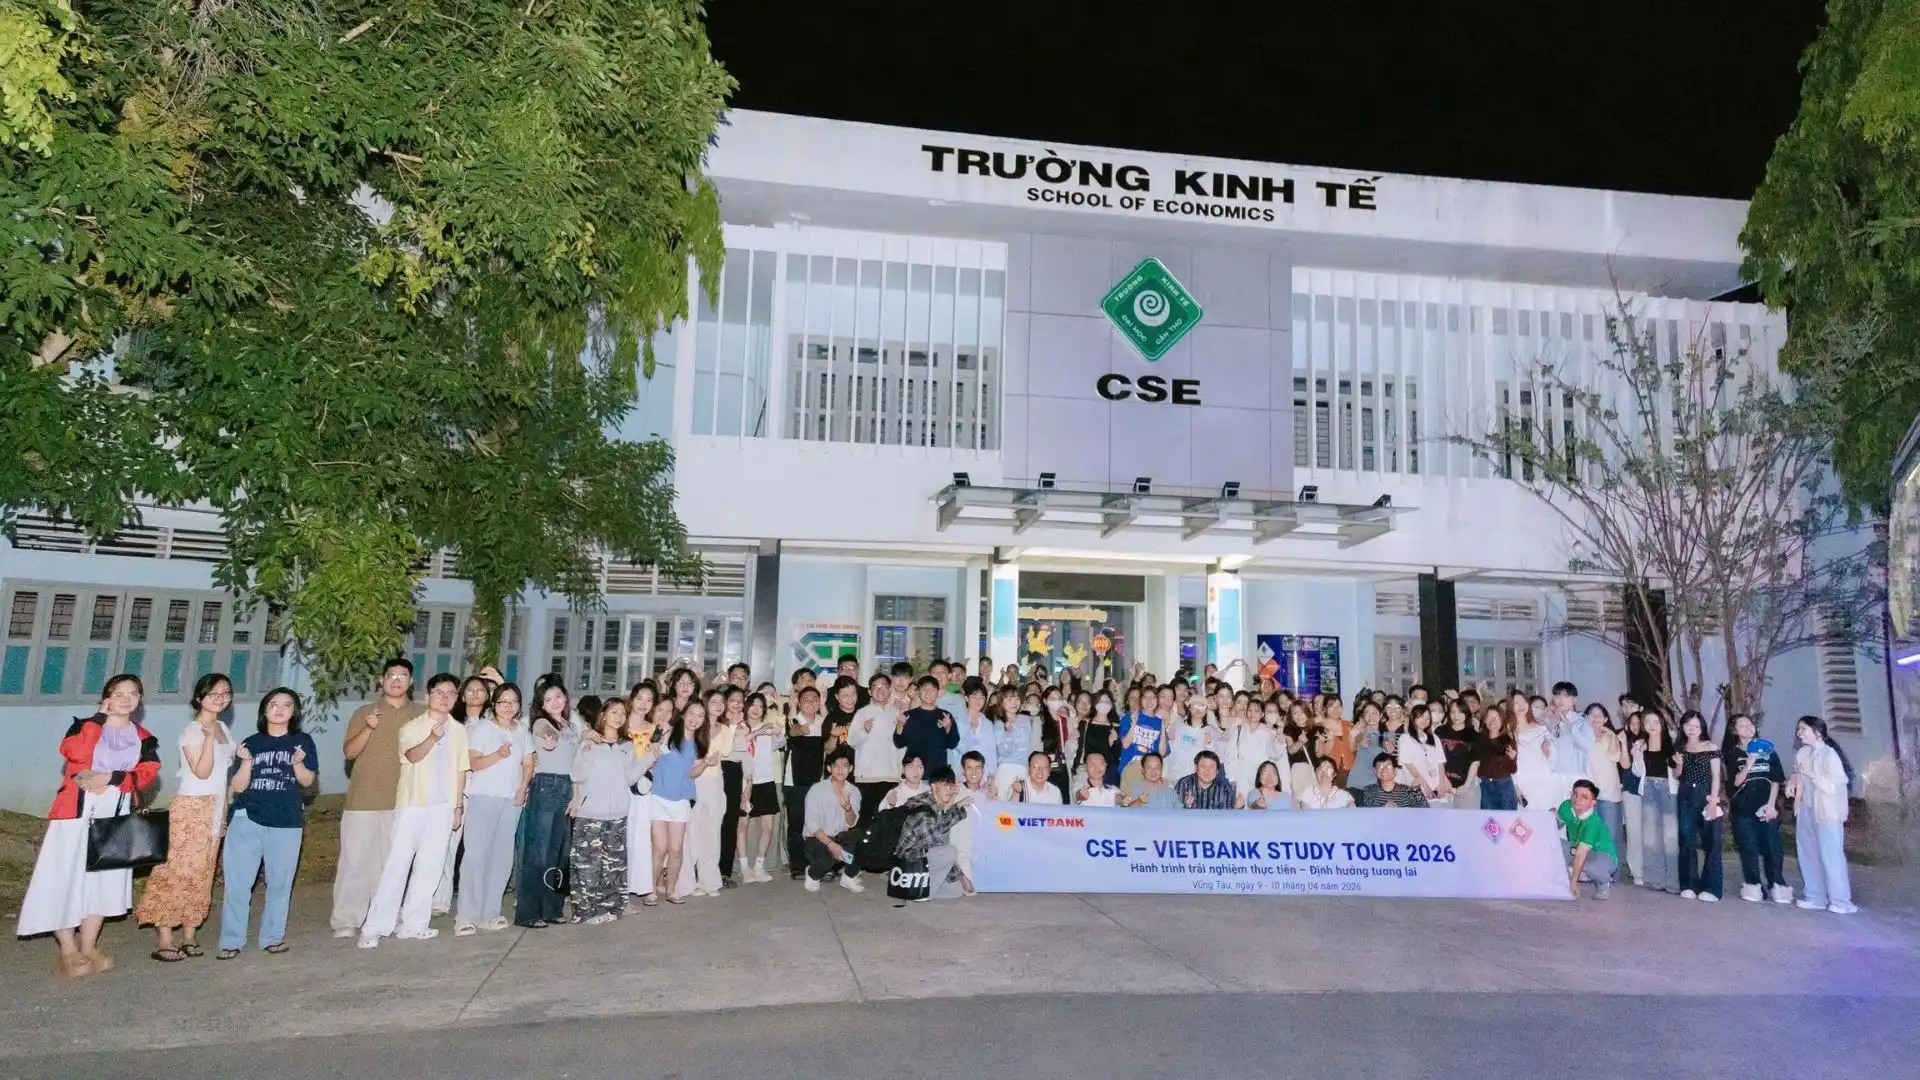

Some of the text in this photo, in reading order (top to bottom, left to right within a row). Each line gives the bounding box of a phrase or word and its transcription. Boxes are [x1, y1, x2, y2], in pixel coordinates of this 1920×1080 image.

[921, 144, 1384, 211] TRƯỜNG KINH TẾ
[1027, 187, 1275, 222] SCHOOL OF ECONOMICS
[1096, 373, 1201, 405] CSE
[1017, 817, 1085, 828] VIETBANK
[1086, 839, 1128, 858] CSE
[1153, 840, 1261, 860] VIETBANK
[1267, 841, 1335, 861] STUDY
[1342, 843, 1400, 862] TOUR
[1407, 844, 1456, 863] 2026
[1131, 863, 1158, 873] Hành
[1405, 866, 1417, 877] lai
[1257, 881, 1262, 889] 9
[1271, 881, 1280, 889] 10
